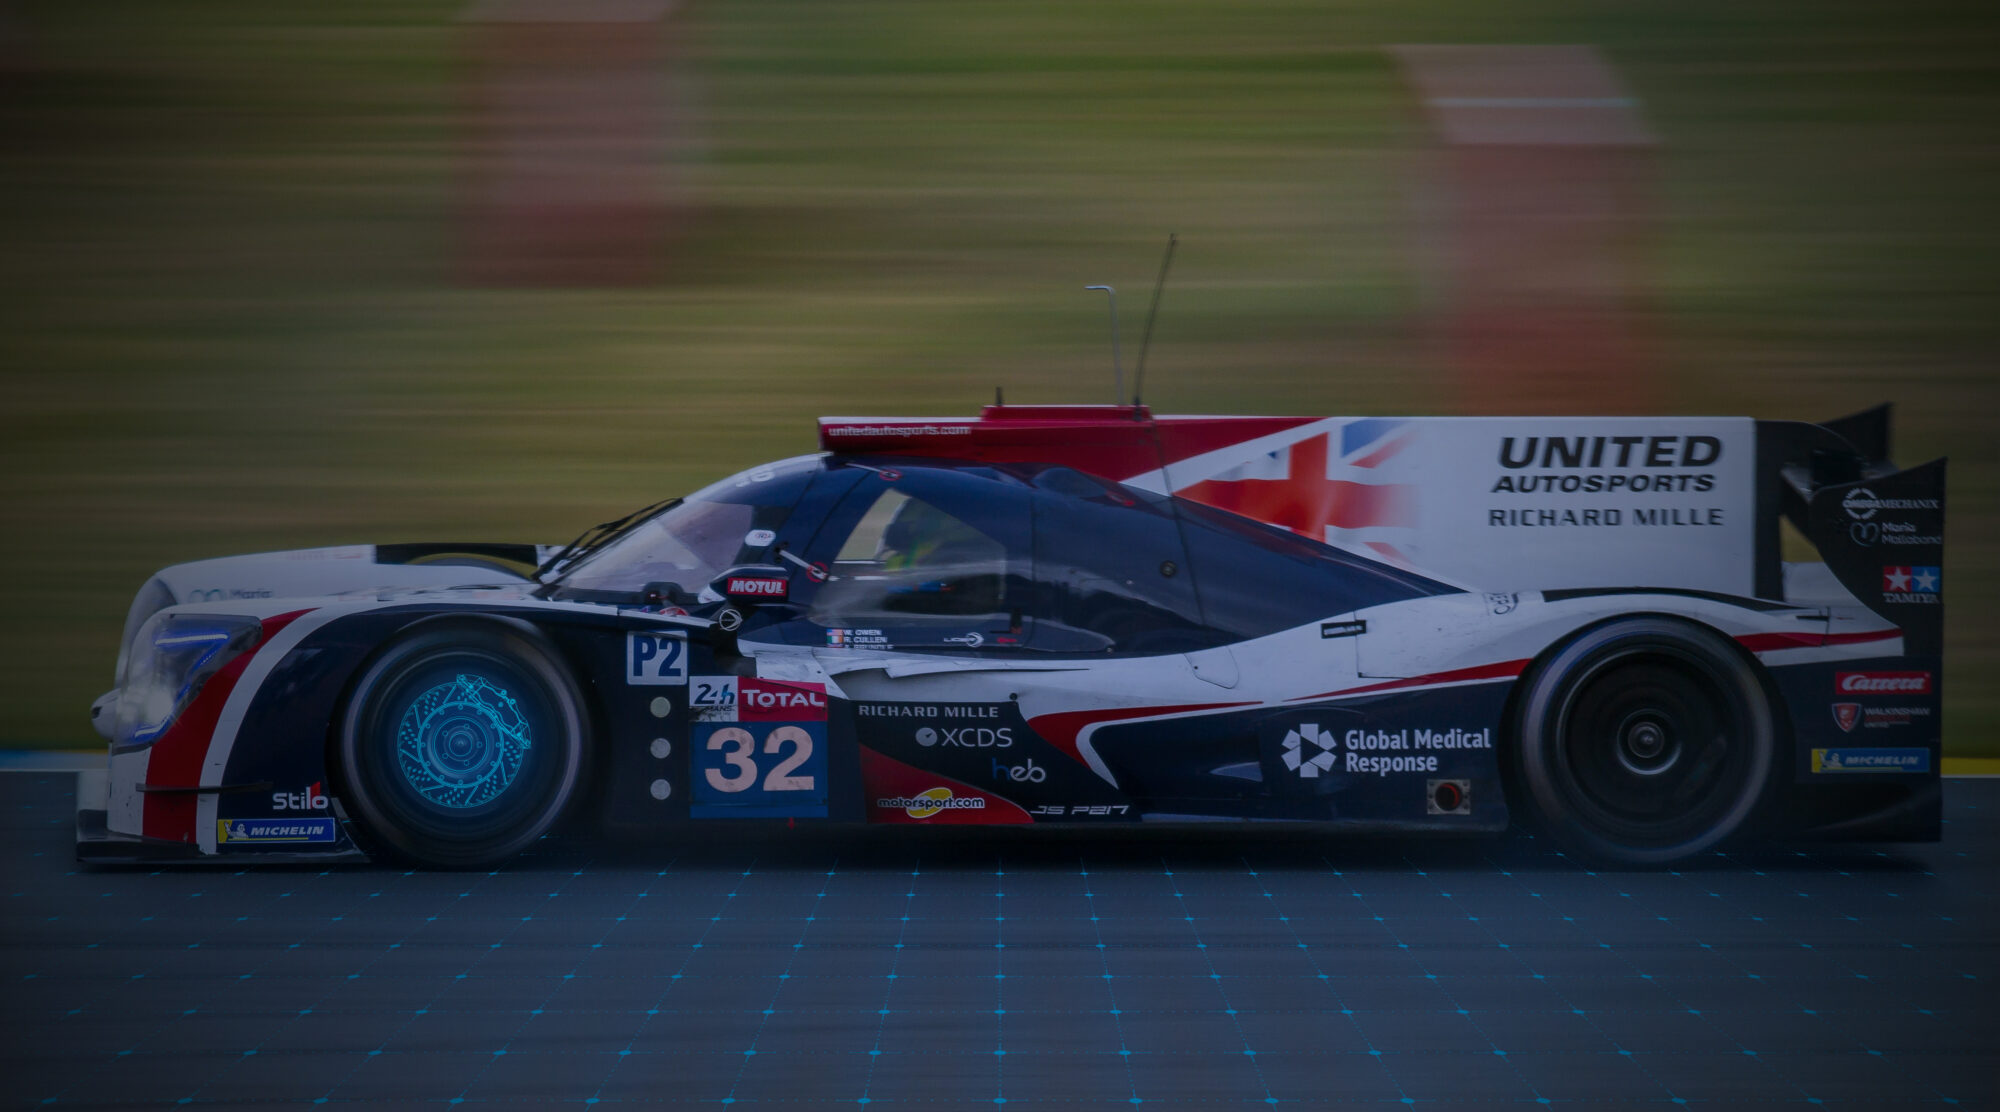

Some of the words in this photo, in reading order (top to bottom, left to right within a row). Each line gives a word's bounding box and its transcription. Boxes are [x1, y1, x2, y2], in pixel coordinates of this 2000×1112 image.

[828, 426, 971, 437] unitedautosports.com
[1499, 436, 1722, 468] UNITED
[1491, 474, 1717, 493] AUTOSPORTS
[1488, 509, 1622, 526] RICHARD
[1632, 508, 1725, 526] MILLE
[730, 580, 785, 594] MOTUL
[1882, 592, 1940, 604] TAMIYA
[633, 635, 681, 677] P2
[1841, 675, 1926, 691] Carrera
[694, 683, 735, 705] 24h
[741, 689, 825, 708] TOTAL
[858, 705, 938, 718] RICHARD
[944, 706, 999, 718] MILLE
[941, 728, 1013, 748] XCDS
[1345, 729, 1408, 750] Global
[1414, 728, 1492, 749] Medical
[704, 725, 815, 793] 32
[1345, 752, 1438, 777] Response
[1844, 756, 1919, 766] MICHELIN
[992, 757, 1046, 783] heb
[272, 784, 329, 810] Stilo
[877, 795, 985, 813] motorsport.com
[1029, 804, 1059, 815] JS
[1071, 804, 1130, 815] P217
[250, 825, 324, 836] MICHELIN
